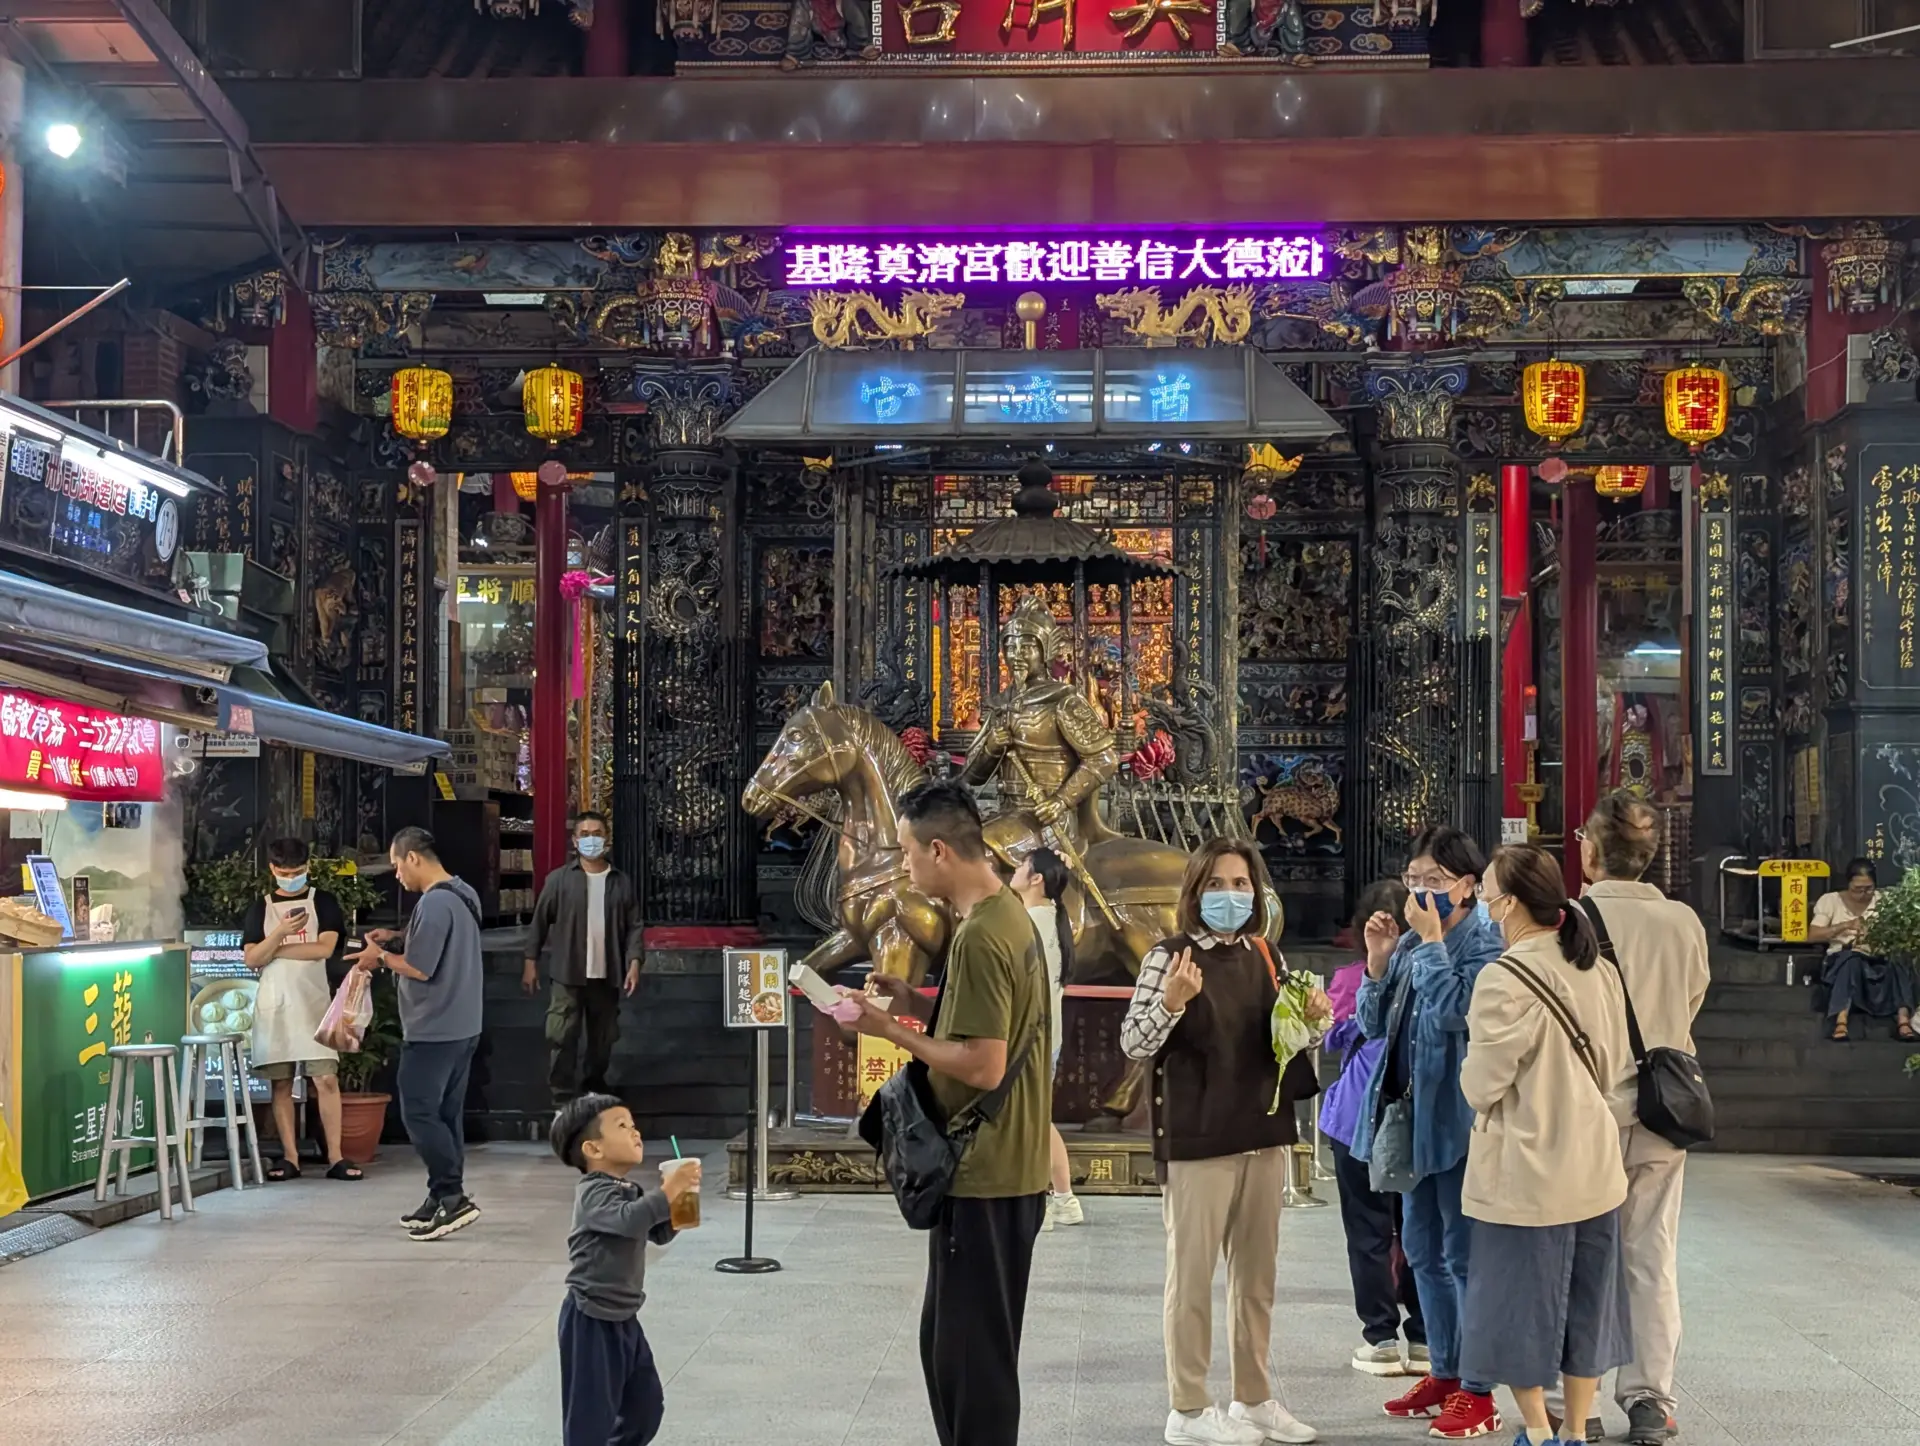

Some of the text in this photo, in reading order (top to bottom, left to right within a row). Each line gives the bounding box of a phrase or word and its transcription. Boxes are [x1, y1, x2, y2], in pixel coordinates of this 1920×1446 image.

[1789, 878, 1804, 936] 雨傘架
[737, 959, 752, 1015] 排隊起點
[1090, 1159, 1113, 1181] 開
